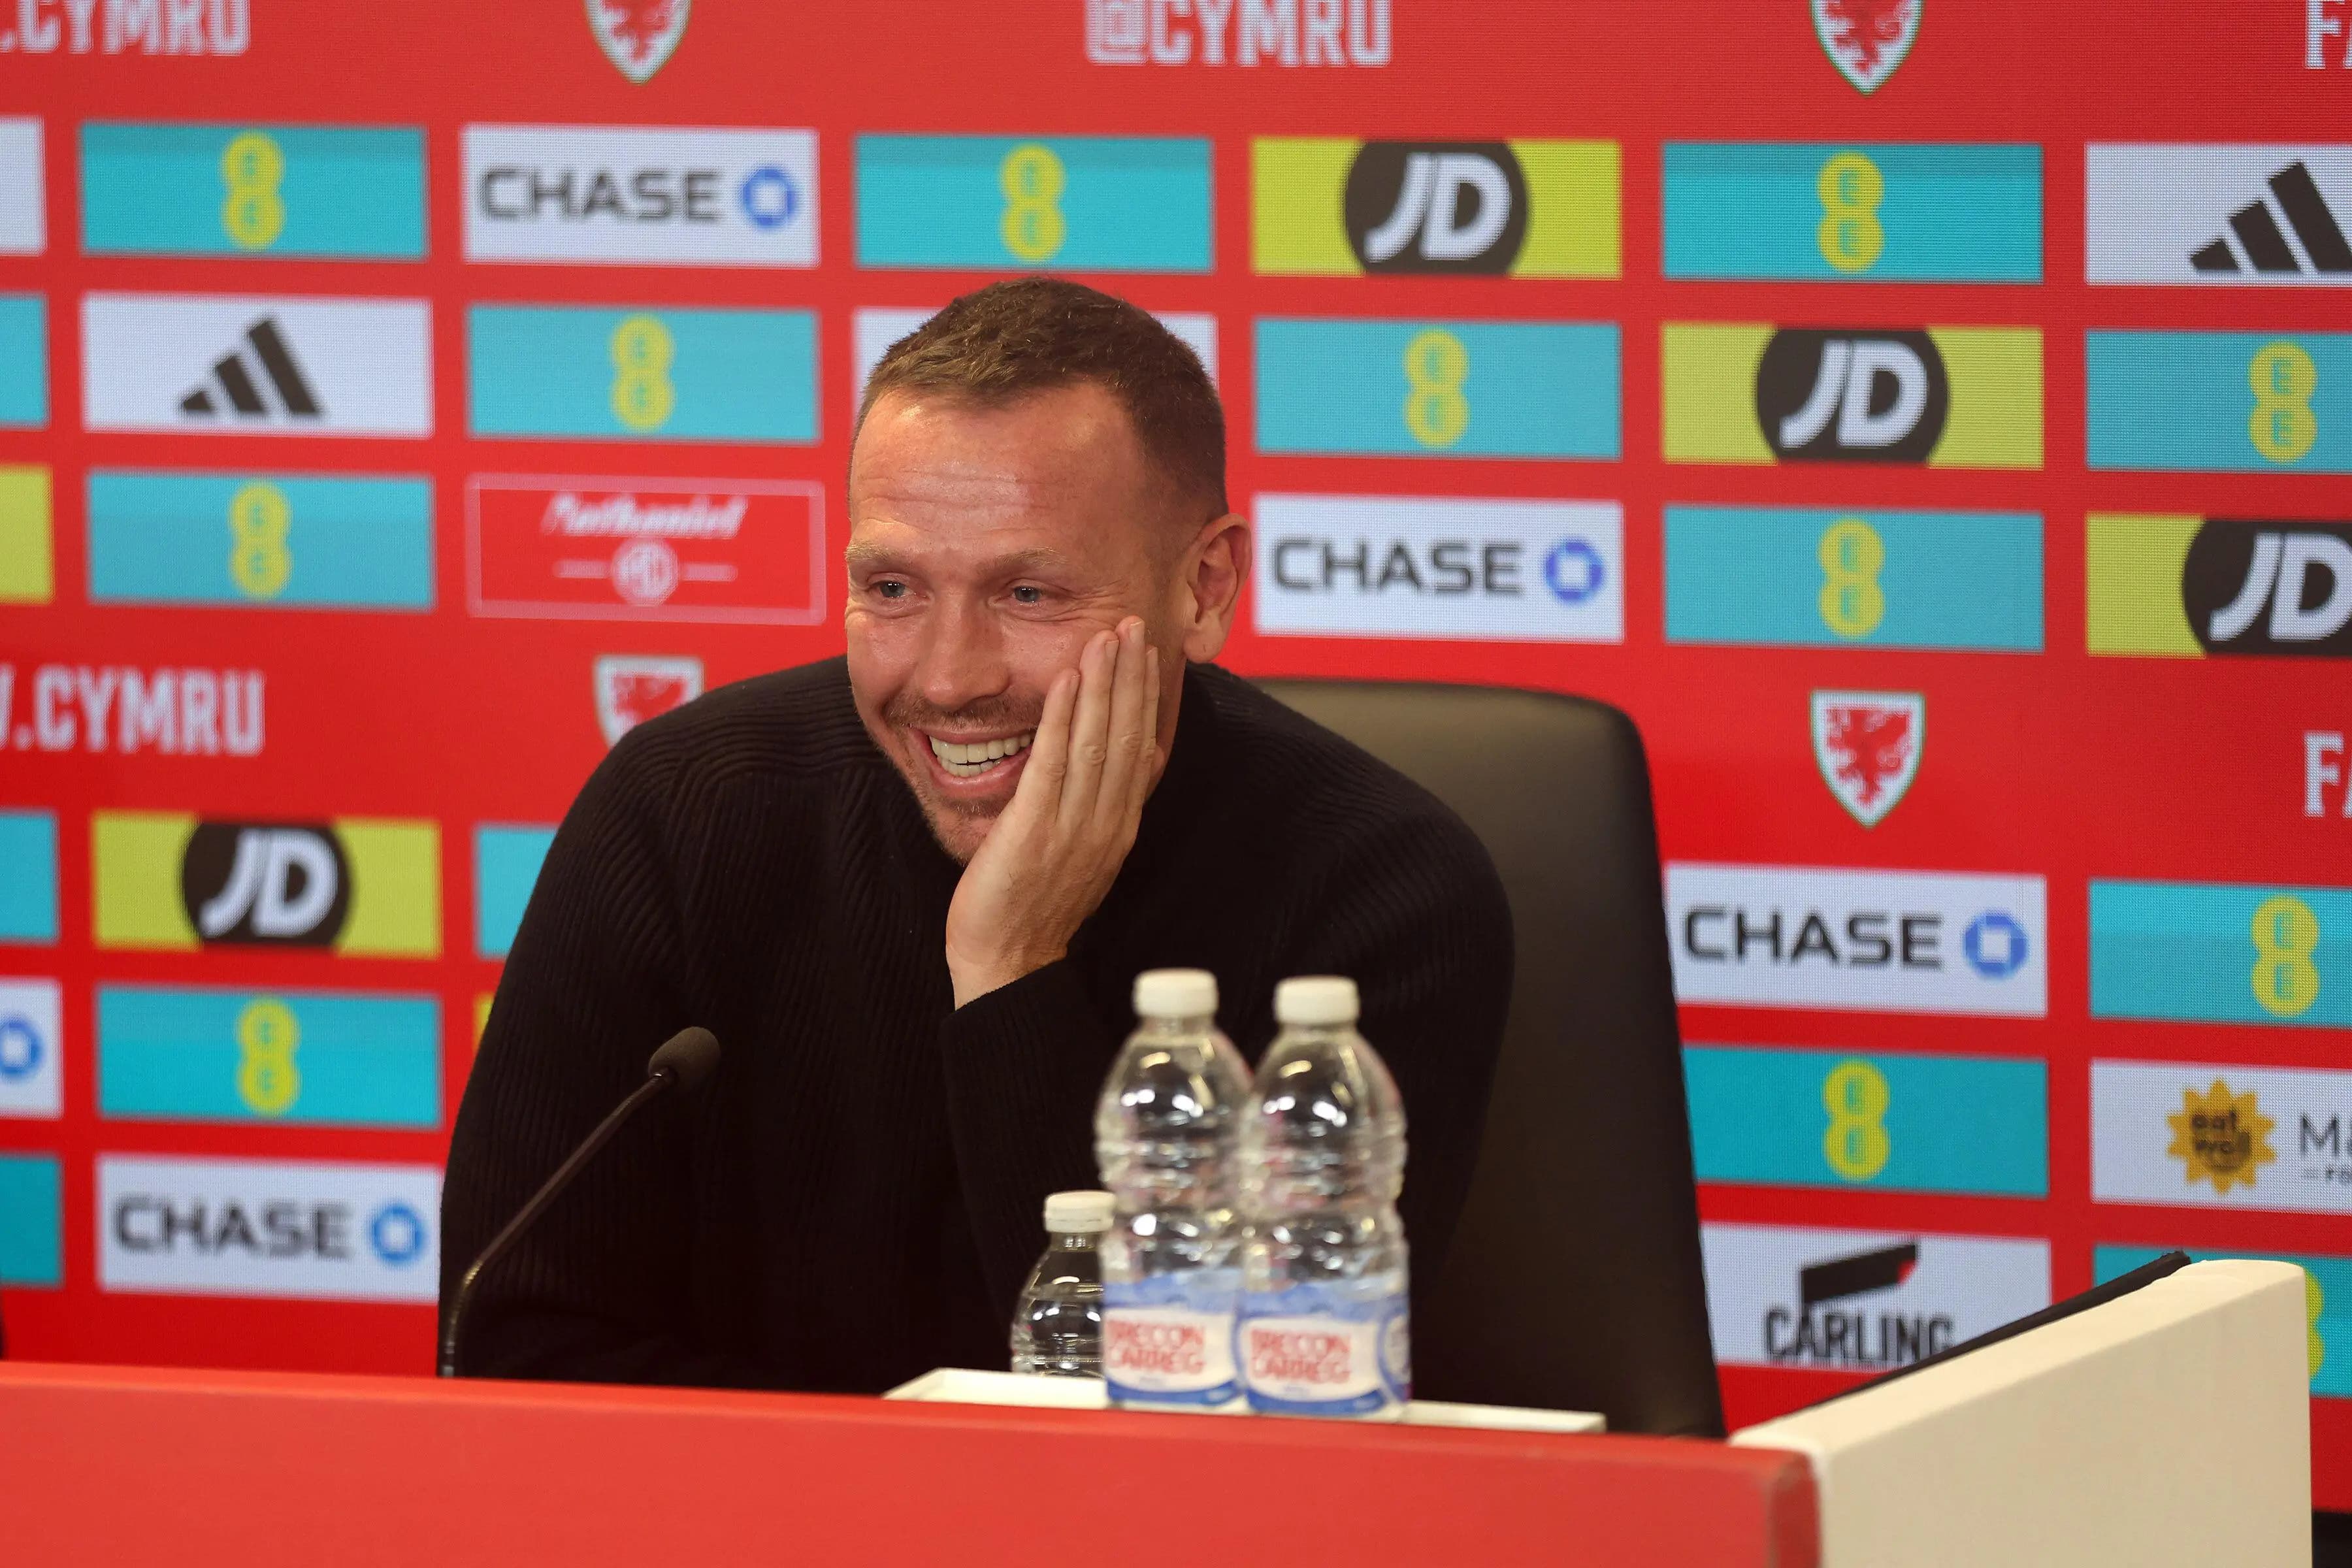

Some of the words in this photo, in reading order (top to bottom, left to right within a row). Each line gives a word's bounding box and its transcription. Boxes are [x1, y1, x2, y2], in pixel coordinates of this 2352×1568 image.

[1086, 0, 1393, 67] @CYMRU
[2306, 0, 2352, 68] F
[481, 165, 723, 223] CHASE
[1364, 152, 1512, 263] JD
[1779, 339, 1928, 448] JD
[1273, 537, 1524, 597] CHASE
[2207, 531, 2352, 643] JD
[2304, 730, 2352, 818] F
[199, 826, 338, 938] JD
[1684, 904, 1943, 970] CHASE
[2299, 1113, 2352, 1155] M
[114, 1193, 355, 1260] CHASE
[1766, 1305, 1954, 1362] CARLING
